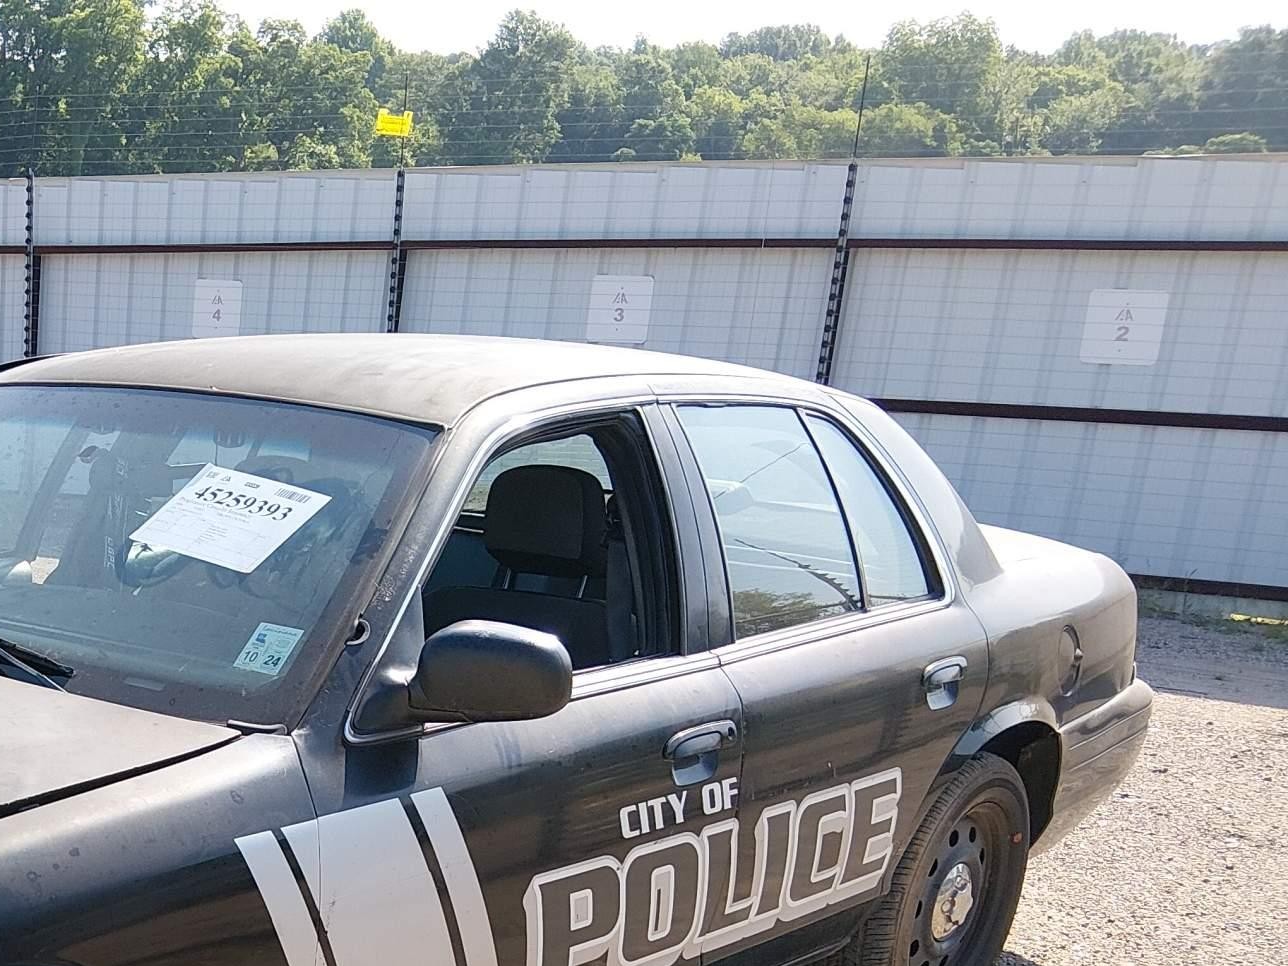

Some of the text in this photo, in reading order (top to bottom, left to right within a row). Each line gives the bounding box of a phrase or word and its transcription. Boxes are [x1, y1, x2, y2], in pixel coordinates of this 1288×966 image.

[212, 308, 222, 322] 4
[613, 307, 625, 322] 3
[1114, 326, 1130, 341] 2
[194, 486, 293, 521] 45259393
[243, 650, 259, 663] 10
[263, 654, 282, 667] 24
[619, 776, 739, 839] CITY OF
